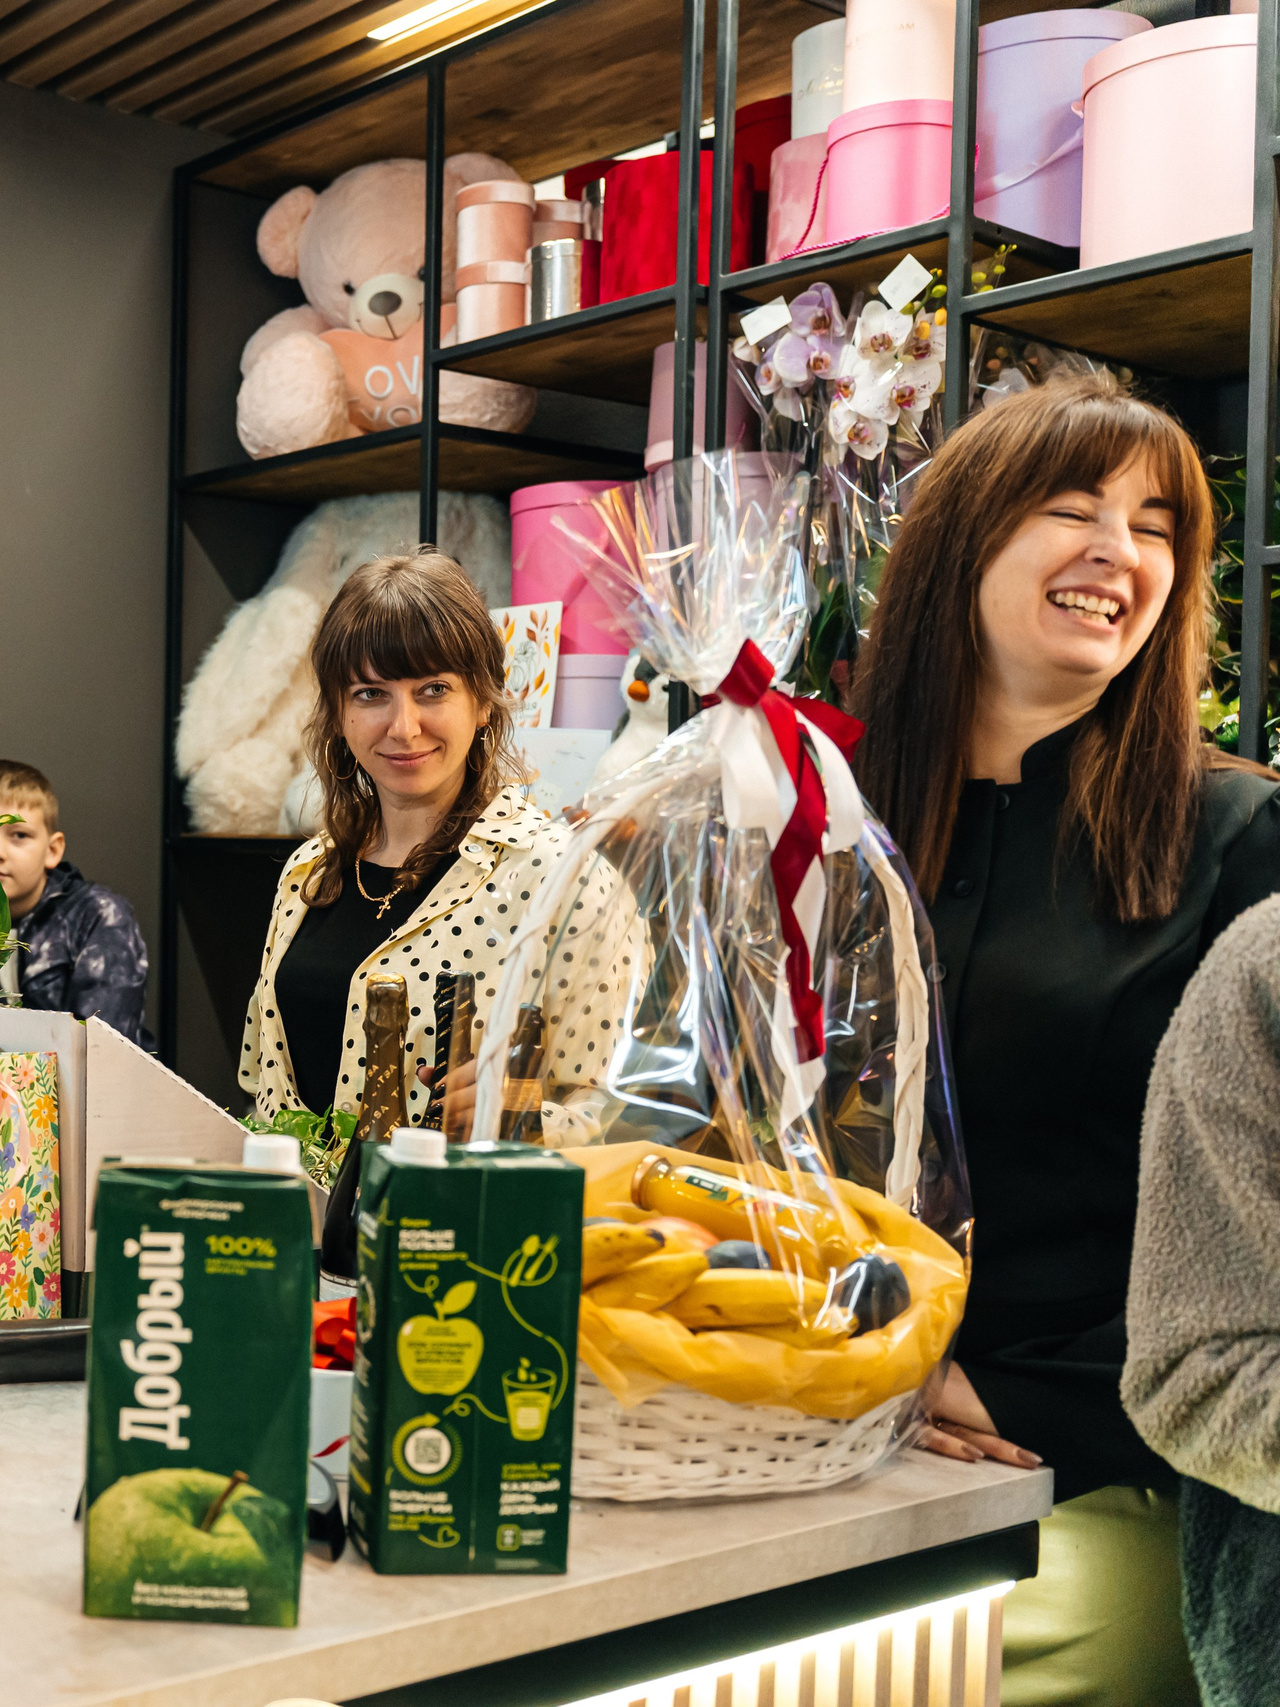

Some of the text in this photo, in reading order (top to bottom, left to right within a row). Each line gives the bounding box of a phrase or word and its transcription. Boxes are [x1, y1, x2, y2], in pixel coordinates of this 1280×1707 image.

[364, 355, 420, 399] OV
[205, 1235, 277, 1258] 100%
[119, 1232, 193, 1450] Добрый
